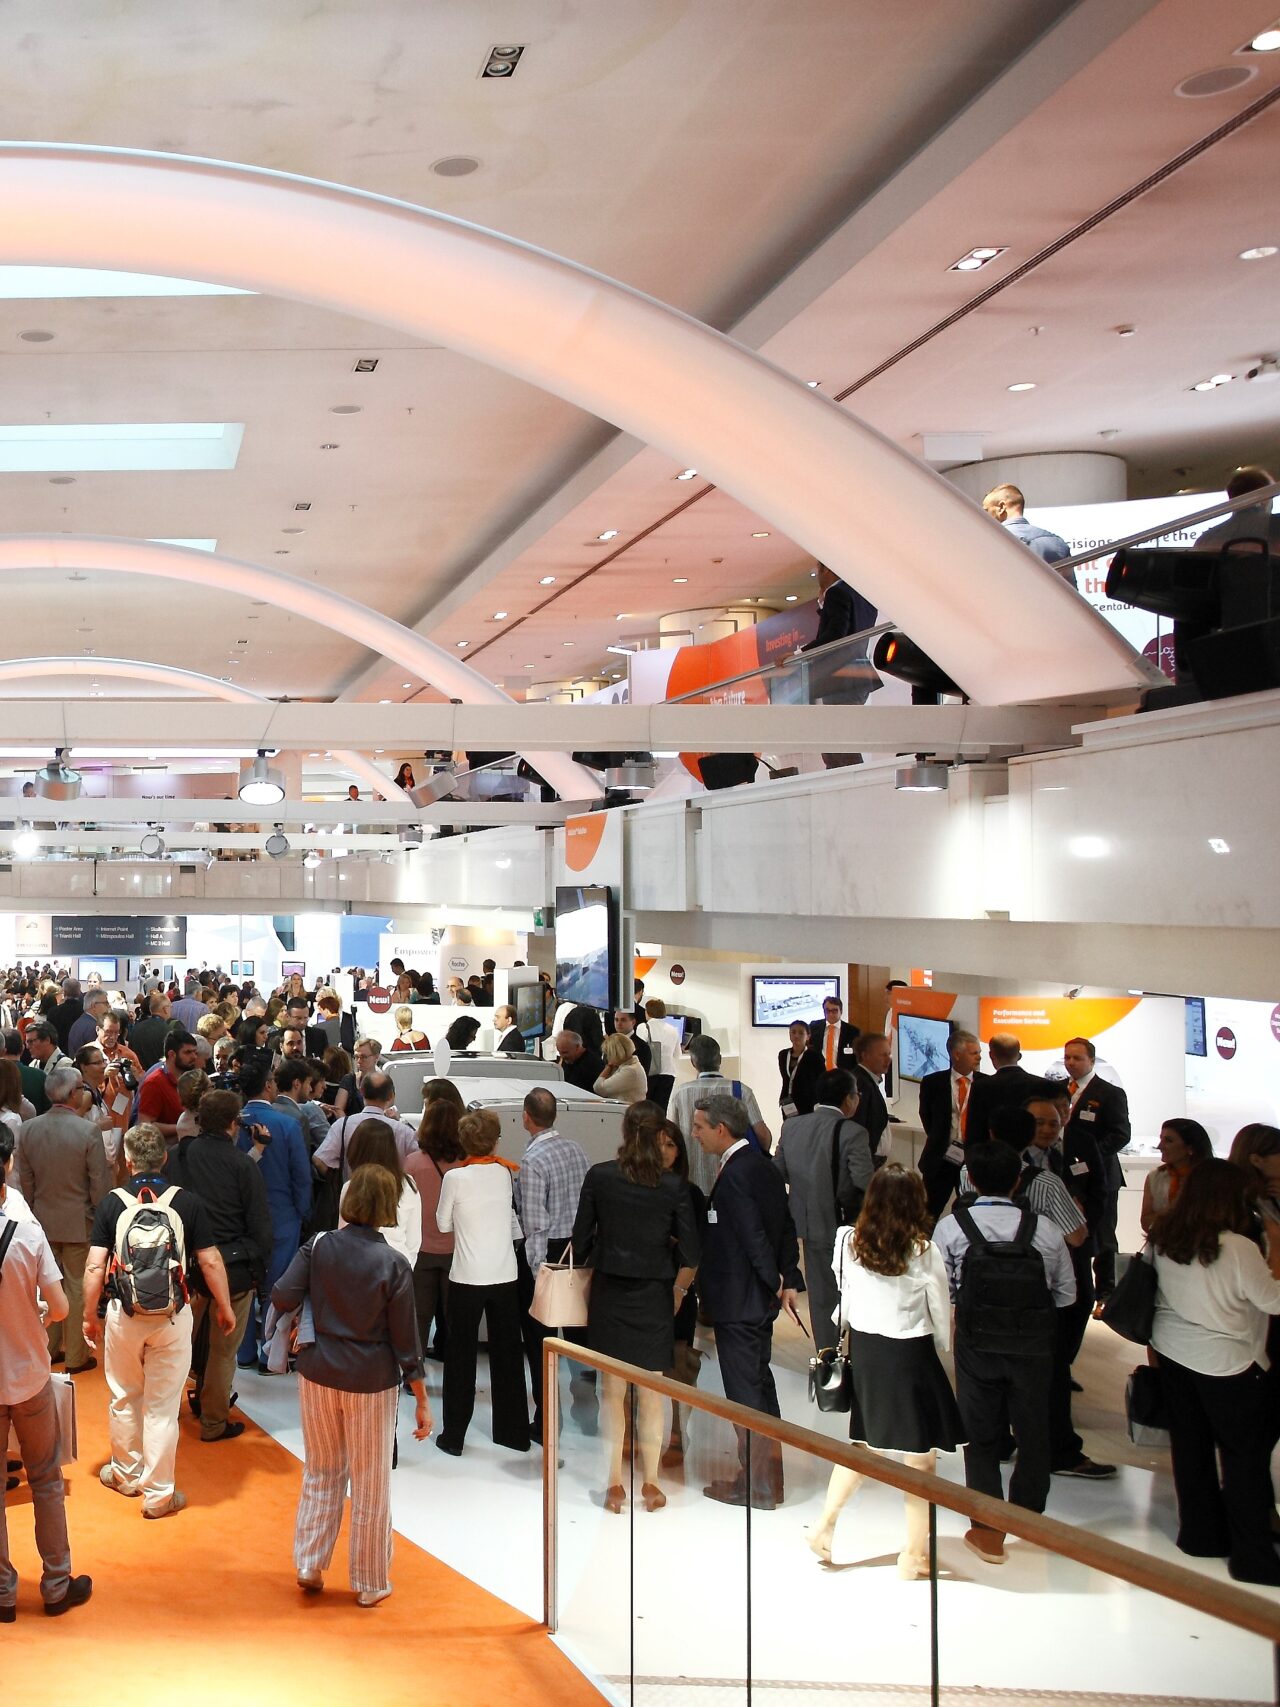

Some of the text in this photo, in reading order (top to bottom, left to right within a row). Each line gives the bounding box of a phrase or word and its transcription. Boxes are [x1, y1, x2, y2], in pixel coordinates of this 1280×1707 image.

[1173, 530, 1197, 542] the
[451, 960, 466, 968] Roche
[369, 995, 390, 1004] New!
[993, 1009, 1032, 1017] Performance
[1023, 1018, 1050, 1026] Services
[1216, 1036, 1236, 1049] New!
